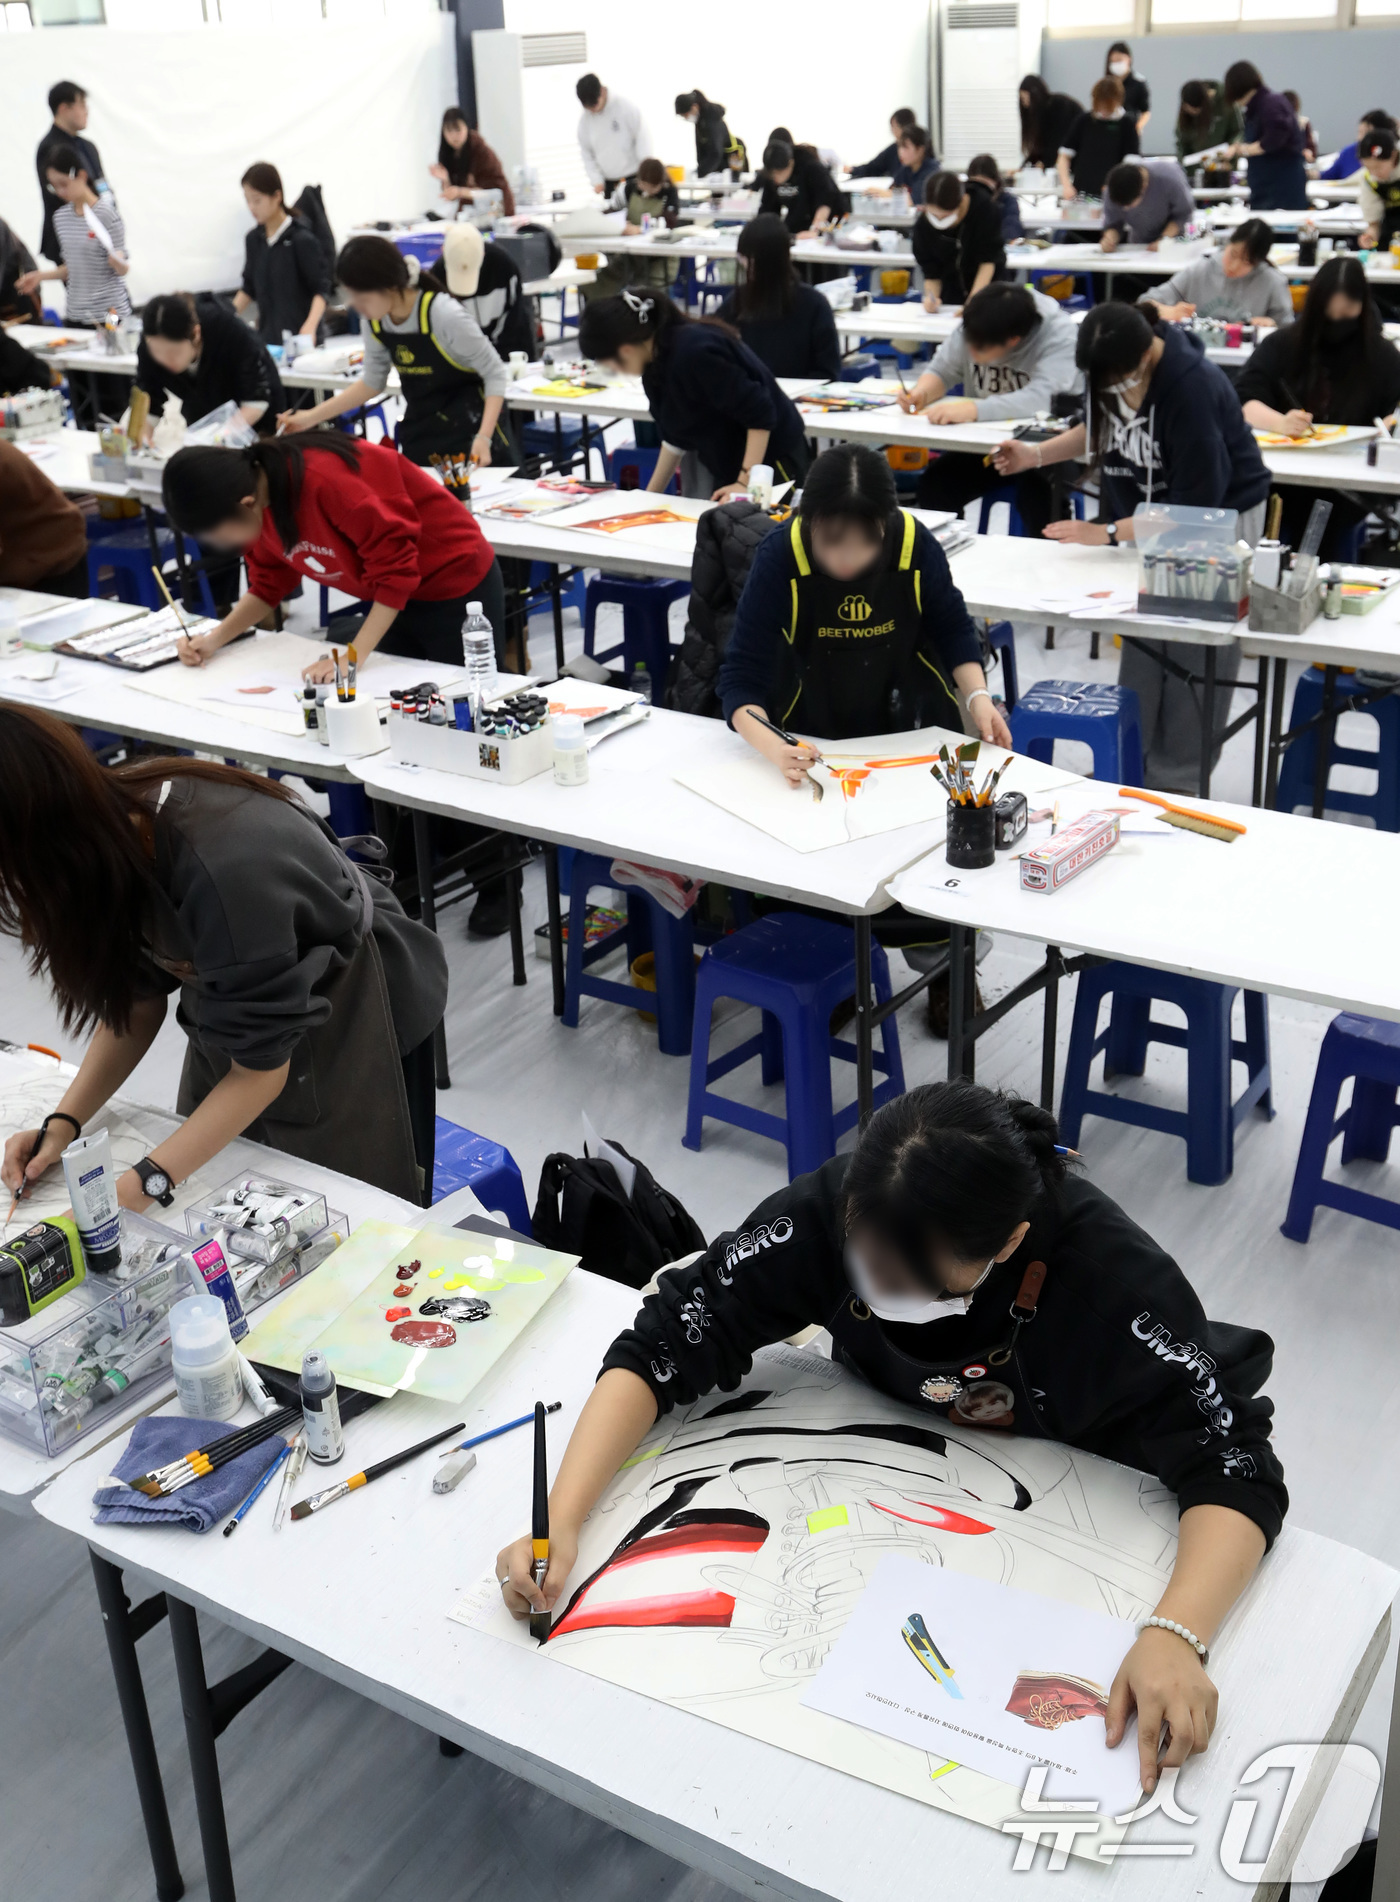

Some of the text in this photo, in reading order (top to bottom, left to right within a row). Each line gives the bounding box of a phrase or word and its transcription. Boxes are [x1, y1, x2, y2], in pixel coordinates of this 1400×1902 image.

[817, 619, 896, 638] BEETWOBEE
[944, 878, 961, 888] 6
[149, 1271, 169, 1287] W357
[1130, 1311, 1221, 1382] UMBR
